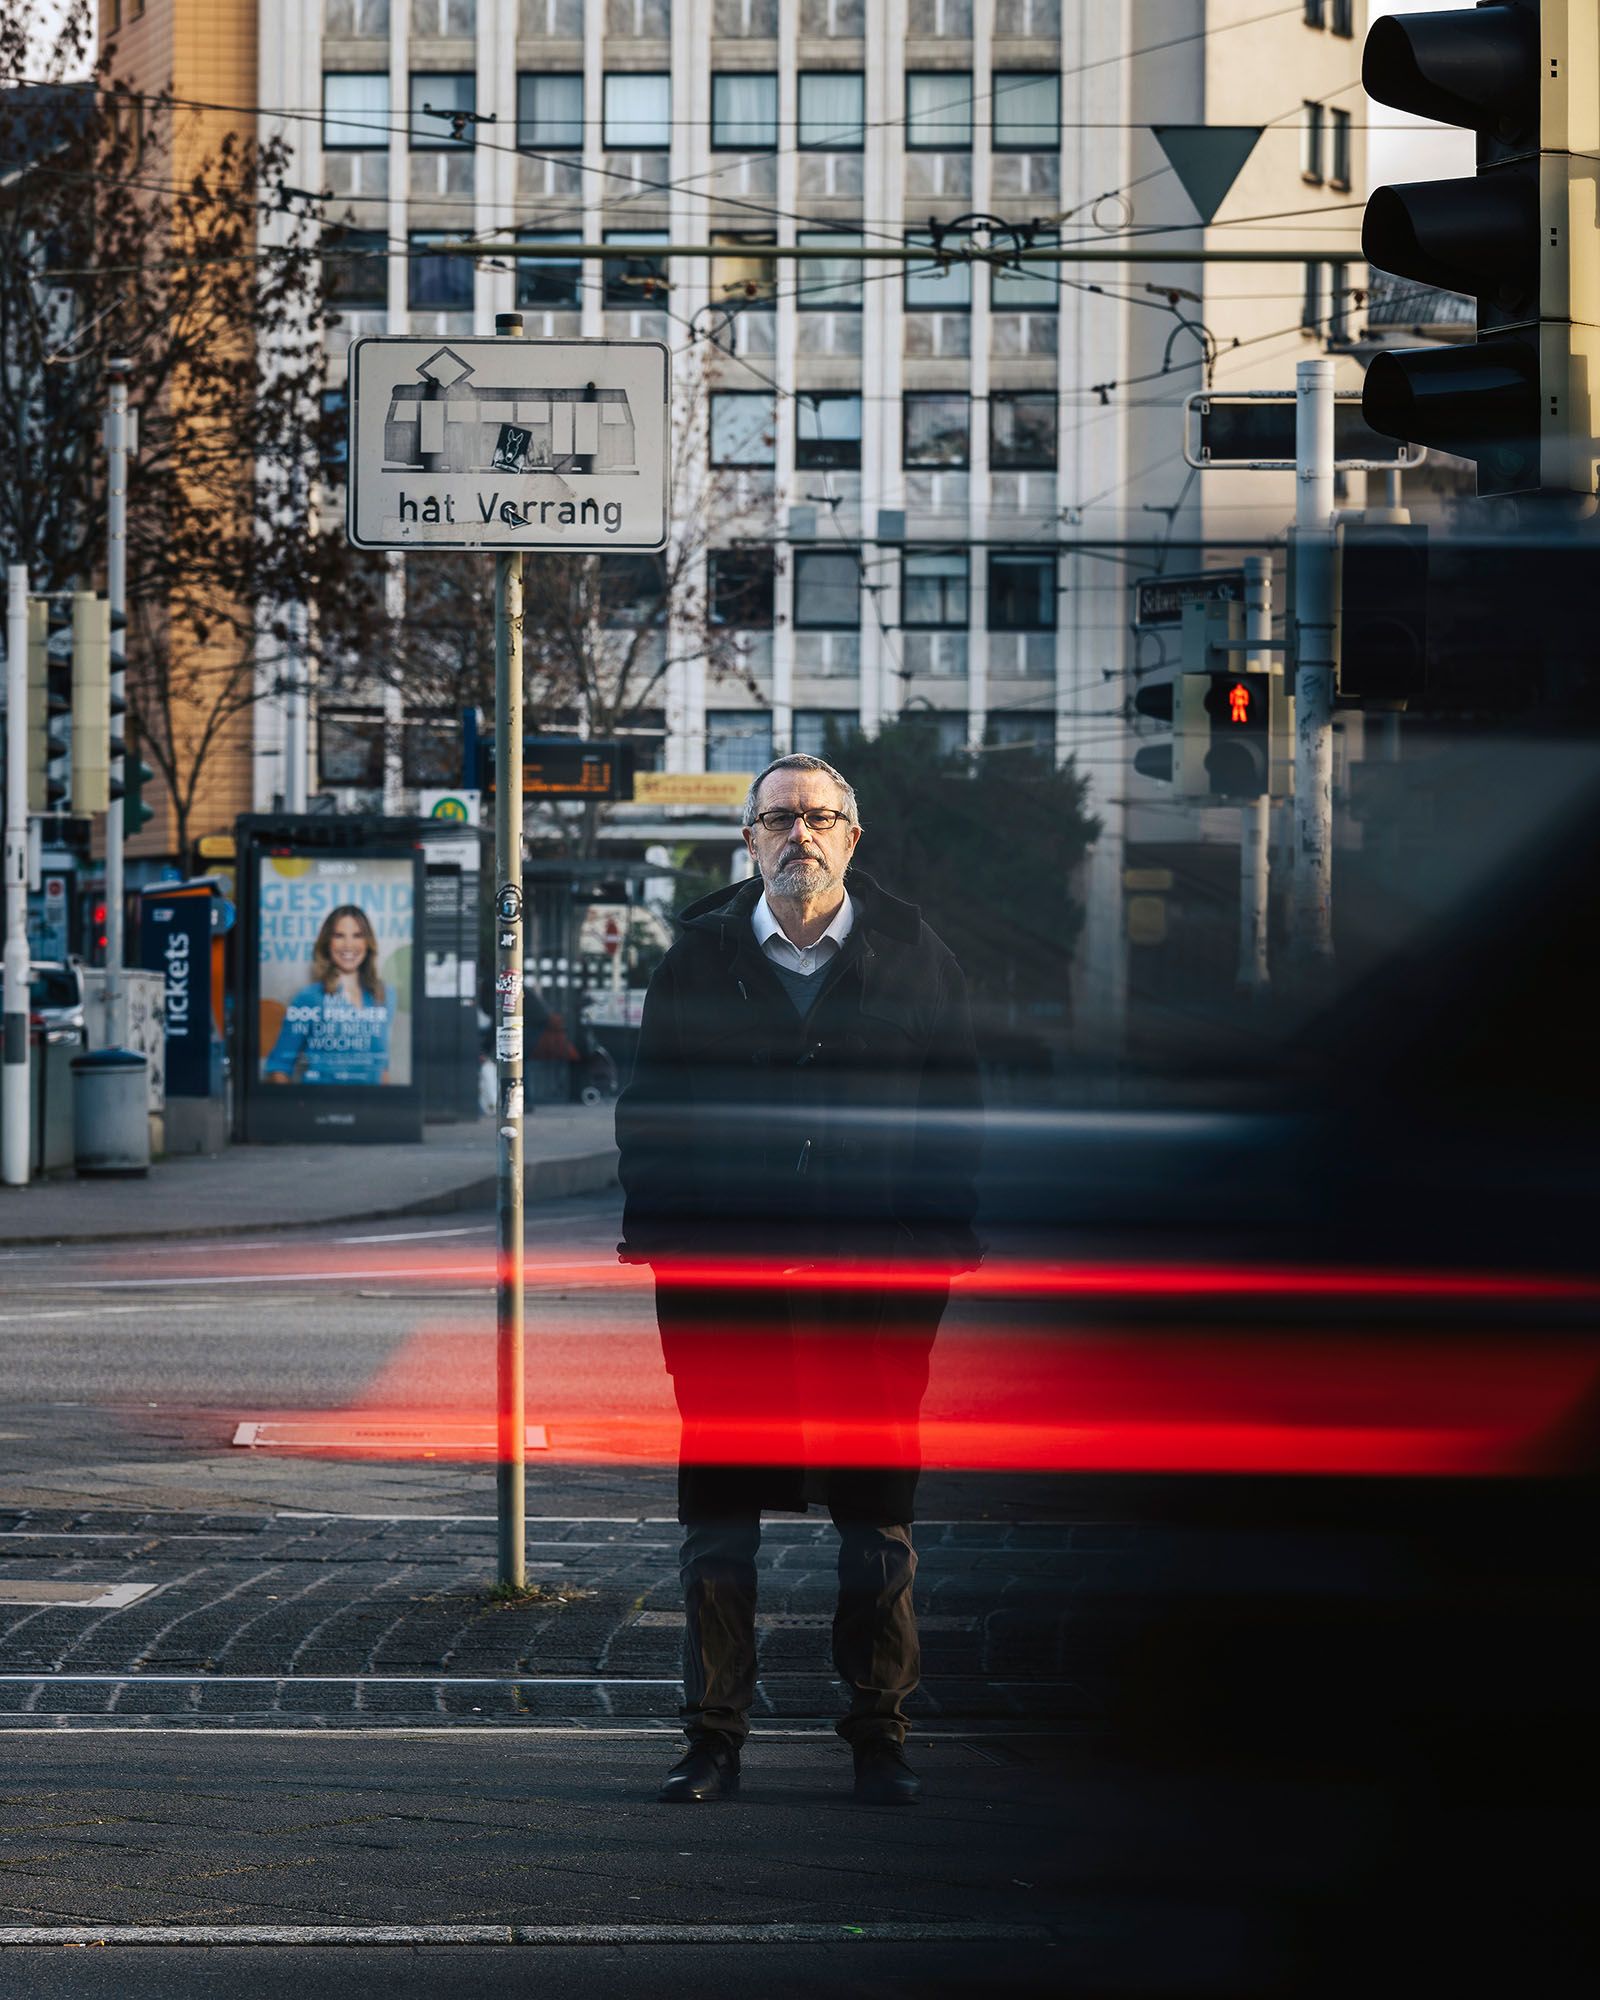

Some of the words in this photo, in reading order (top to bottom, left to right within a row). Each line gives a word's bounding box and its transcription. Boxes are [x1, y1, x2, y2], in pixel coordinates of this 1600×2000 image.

[399, 492, 455, 524] hat
[261, 882, 412, 912] GESUND
[164, 933, 189, 1036] Tickets
[286, 1006, 321, 1022] DOC
